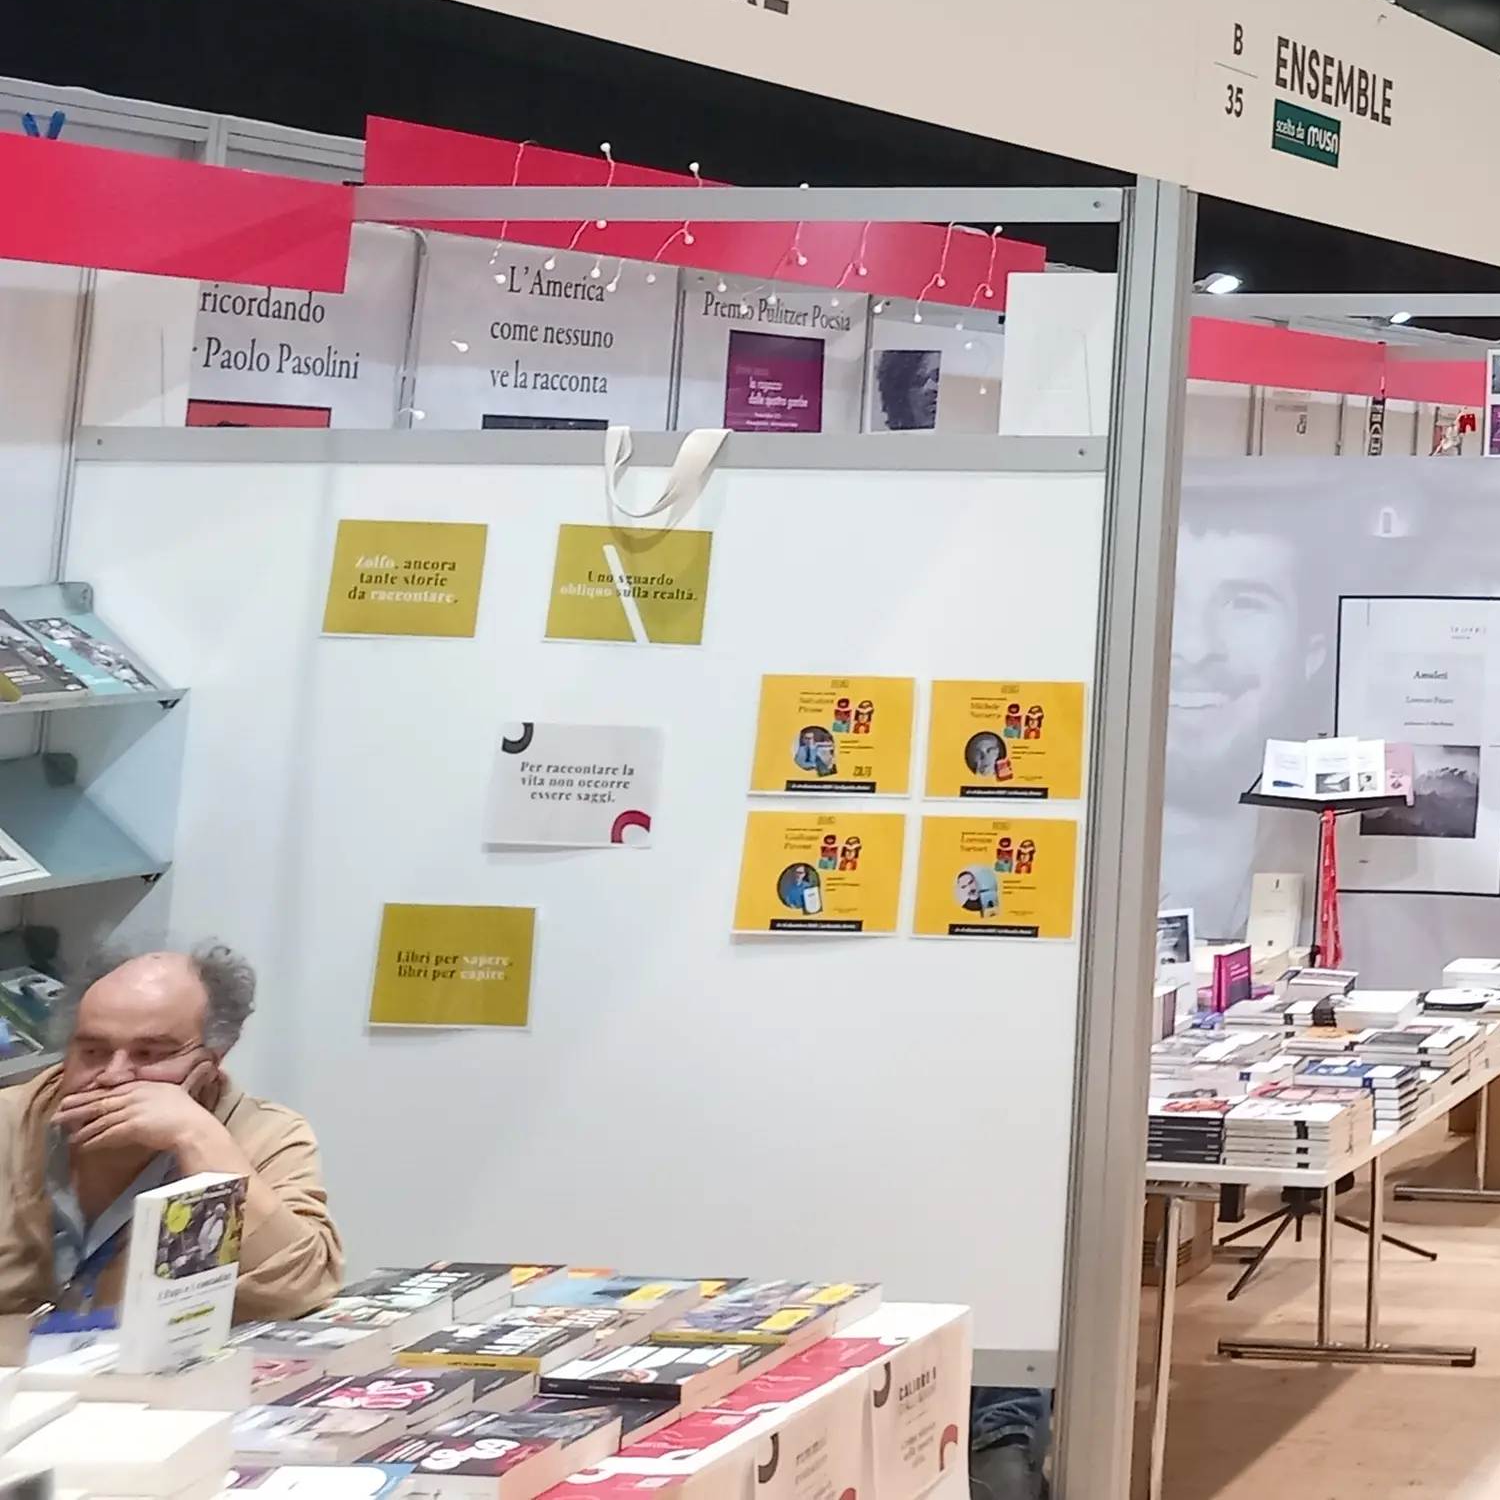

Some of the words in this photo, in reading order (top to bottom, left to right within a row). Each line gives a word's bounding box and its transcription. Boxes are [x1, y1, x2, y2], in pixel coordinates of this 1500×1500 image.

[1233, 22, 1243, 56] B
[1275, 35, 1393, 126] ENSEMBLE
[1225, 84, 1243, 118] 35
[200, 284, 325, 323] ricordando
[758, 298, 808, 327] Pulitzer
[811, 305, 851, 331] Poesia
[490, 321, 539, 342] come
[543, 325, 614, 349] nessuno
[202, 337, 270, 372] Paolo
[276, 343, 360, 379] Pasolini
[490, 368, 509, 387] ve
[513, 359, 528, 389] la
[532, 371, 608, 394] racconta
[403, 560, 456, 571] ancora
[360, 572, 398, 585] tante
[404, 572, 448, 587] storie
[588, 570, 614, 583] Uno
[617, 573, 674, 587] sguardo
[348, 586, 366, 600] da
[616, 587, 649, 599] sulla
[520, 761, 542, 773] Per
[546, 763, 619, 776] raccontare
[622, 763, 635, 776] la
[521, 776, 545, 787] vita
[549, 777, 574, 787] non
[578, 778, 630, 789] occorre
[530, 791, 572, 801] essere
[397, 951, 430, 964] Libri
[434, 955, 459, 966] per
[398, 966, 429, 978] libri
[431, 969, 456, 982] per
